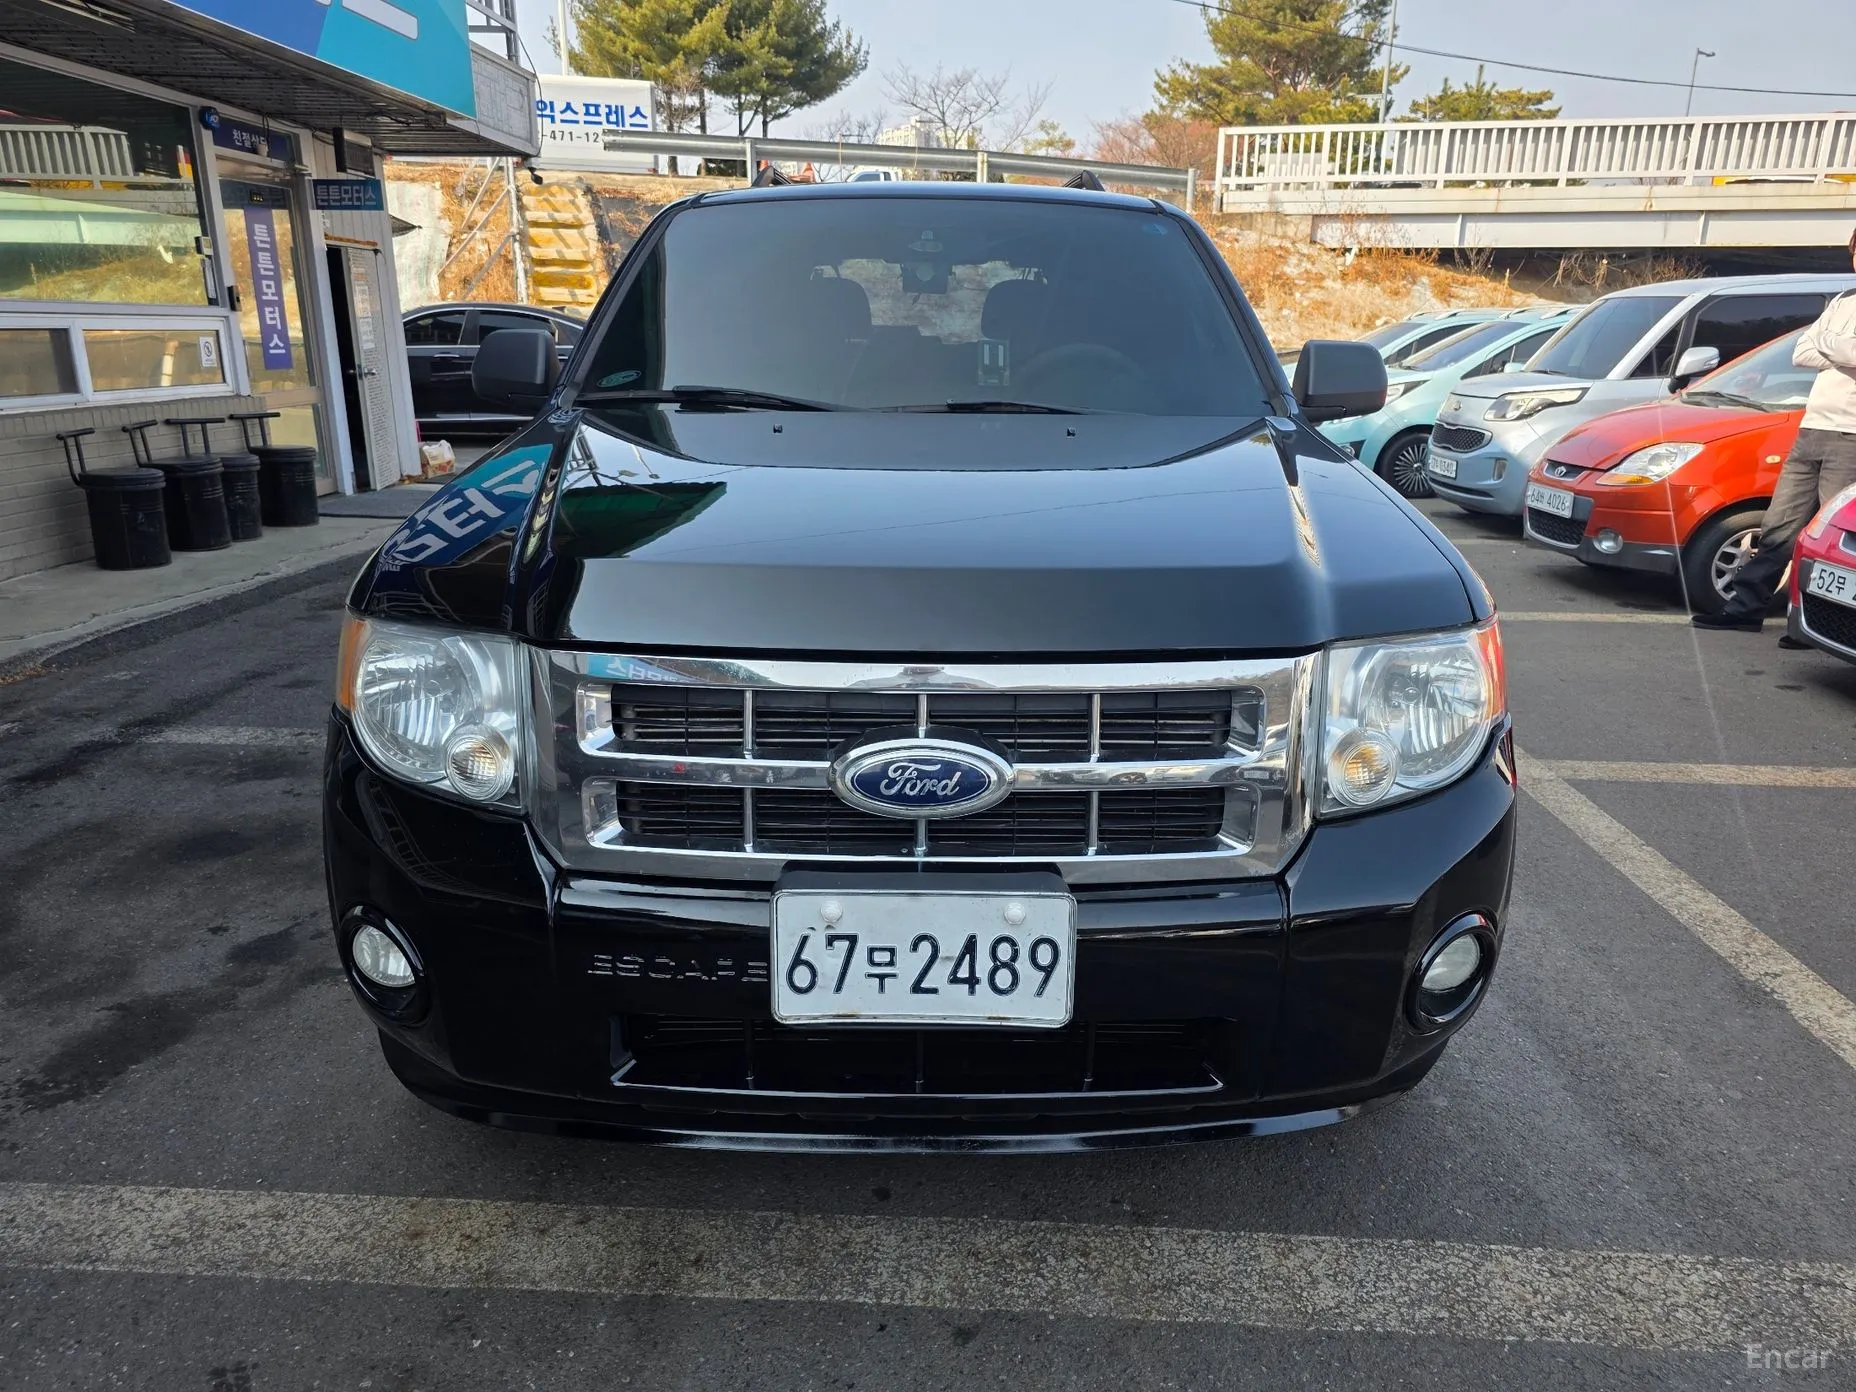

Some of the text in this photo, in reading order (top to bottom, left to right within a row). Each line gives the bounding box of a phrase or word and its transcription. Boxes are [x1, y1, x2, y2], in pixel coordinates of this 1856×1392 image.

[536, 99, 648, 129] 익스프레스
[543, 129, 600, 144] -471-12
[316, 184, 377, 206] 튼튼모터스
[253, 223, 286, 354] 튼튼모터스
[879, 762, 962, 796] Ford
[587, 954, 768, 982] ESCAPE
[785, 933, 1061, 998] 67무2489
